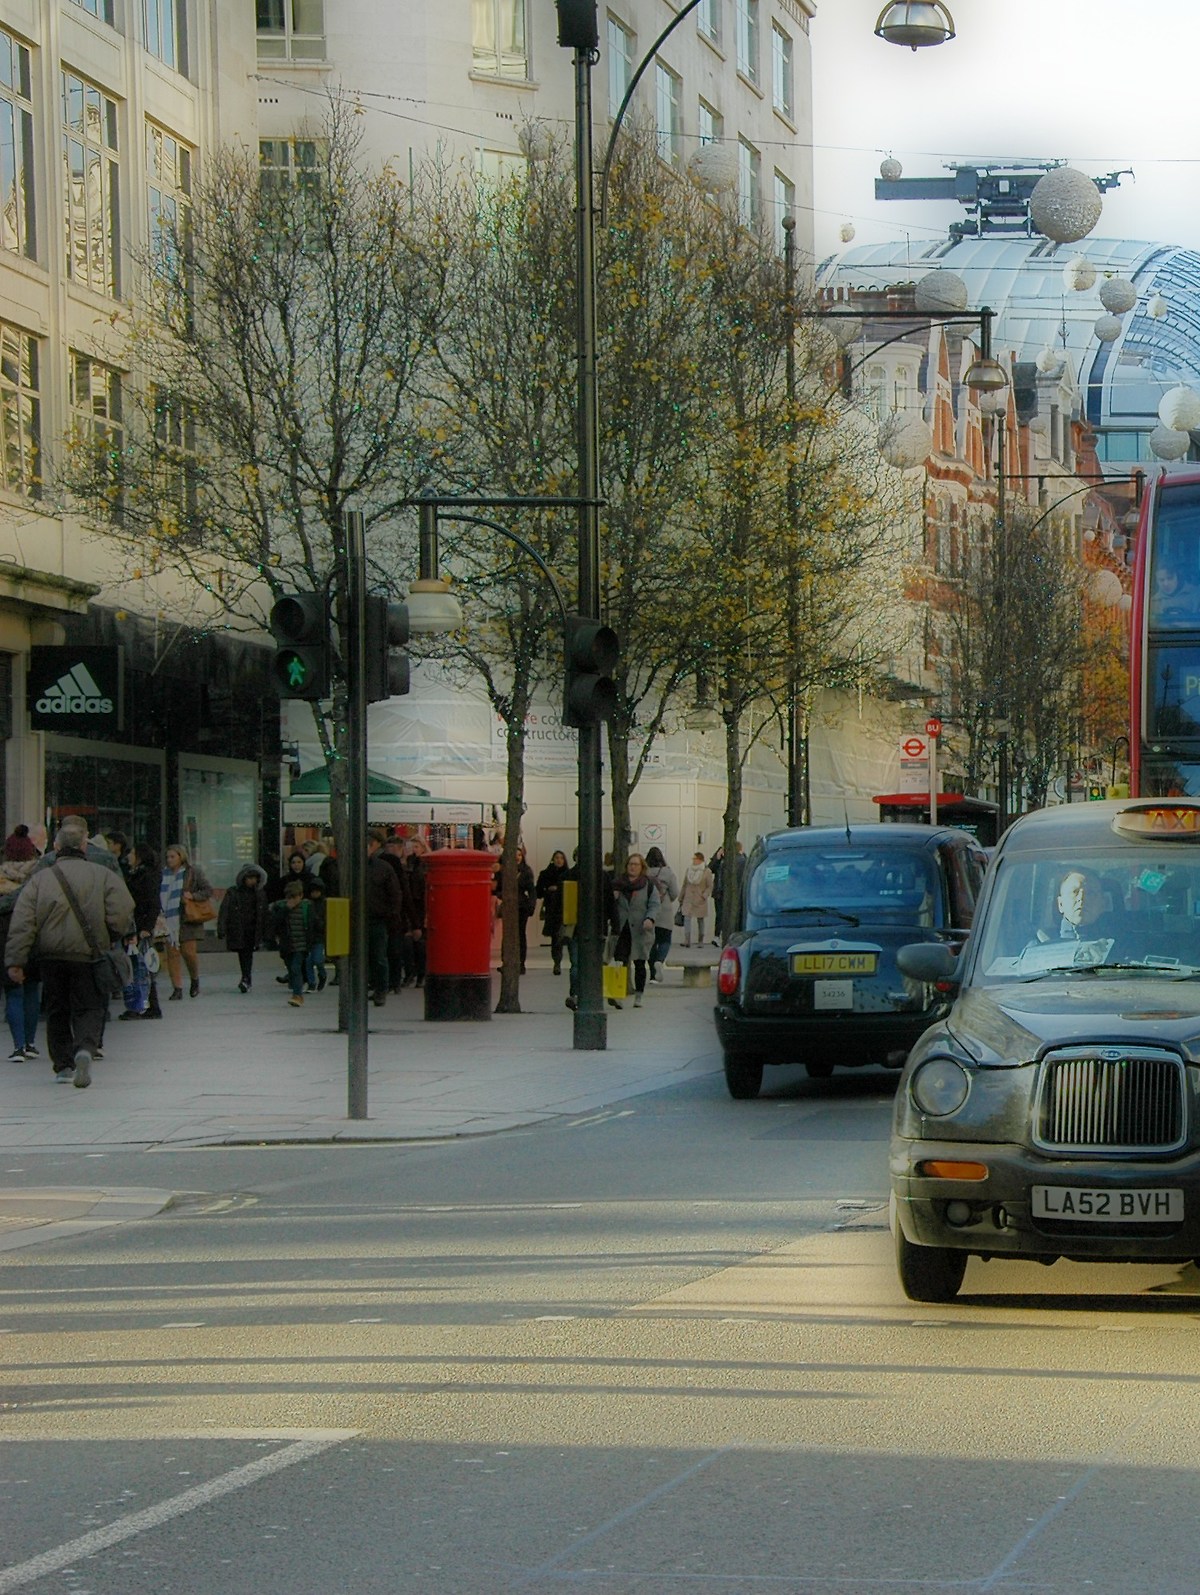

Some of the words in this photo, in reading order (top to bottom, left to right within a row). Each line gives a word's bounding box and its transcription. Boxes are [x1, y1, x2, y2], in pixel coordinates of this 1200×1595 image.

[35, 695, 113, 713] adidas
[927, 724, 938, 732] BU
[803, 957, 834, 970] LL17
[1044, 1189, 1111, 1216] LA52
[1120, 1192, 1170, 1216] BVH
